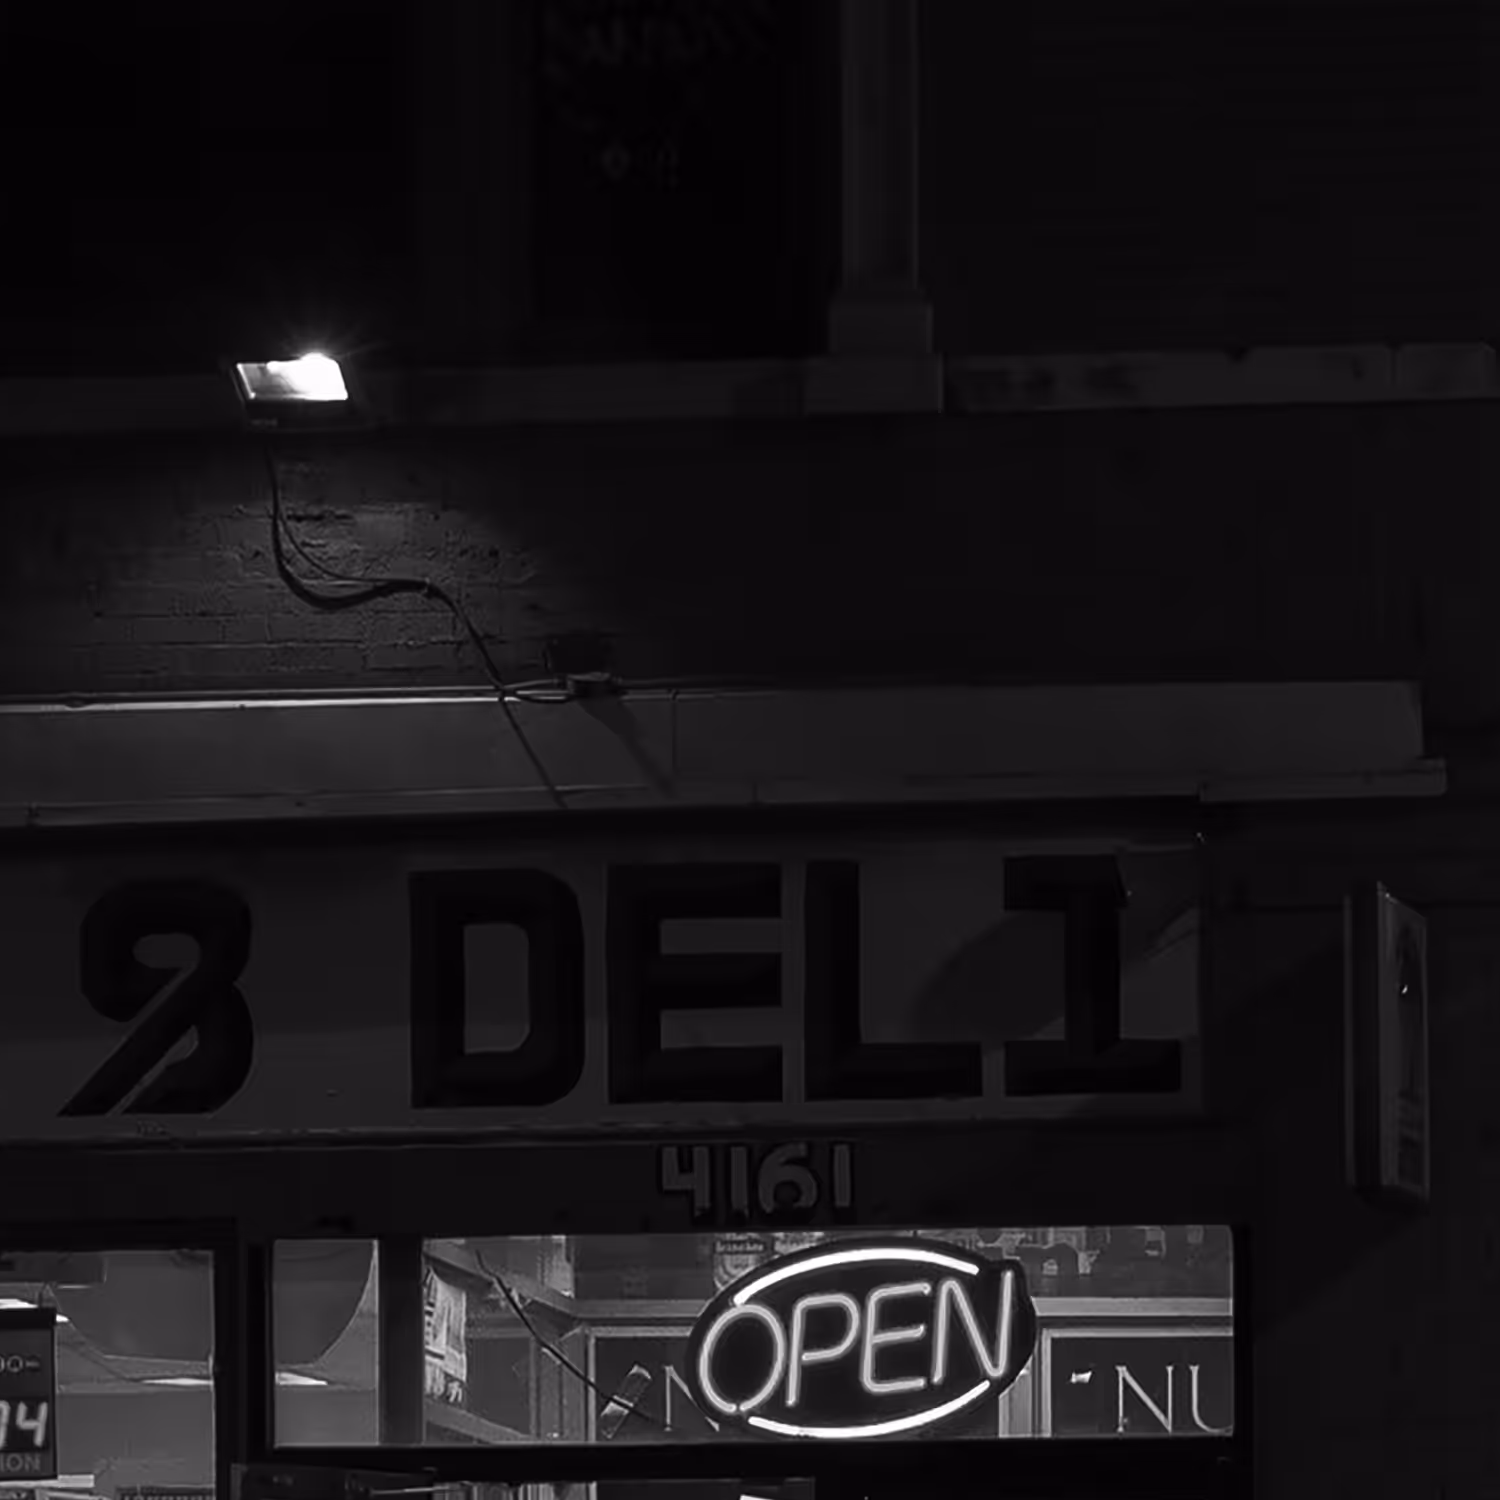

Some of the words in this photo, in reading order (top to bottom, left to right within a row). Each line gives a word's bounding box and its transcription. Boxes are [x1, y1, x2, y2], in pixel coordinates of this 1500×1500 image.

[56, 876, 255, 1117] &
[408, 855, 1181, 1108] DELI
[661, 1142, 853, 1217] 4161
[700, 1268, 1014, 1413] OPEN
